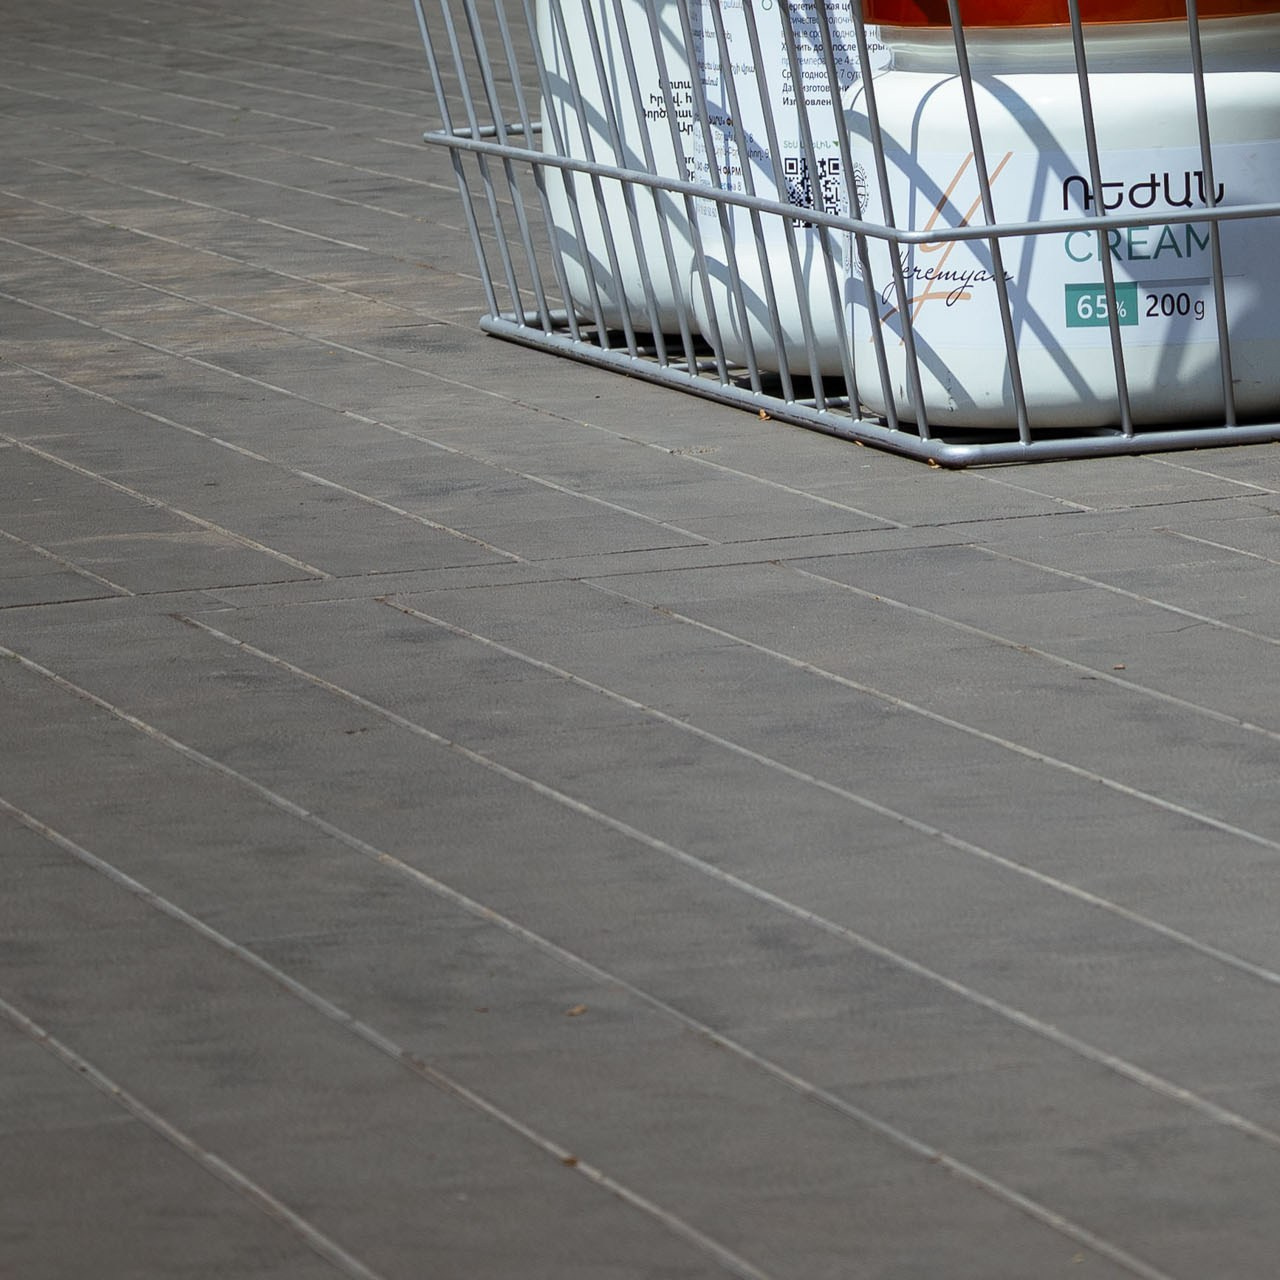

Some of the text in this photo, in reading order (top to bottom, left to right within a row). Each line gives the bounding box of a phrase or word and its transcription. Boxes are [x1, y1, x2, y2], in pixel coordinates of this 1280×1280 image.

[1062, 170, 1225, 211] ՌԵԺԱՆ
[1064, 223, 1213, 263] CREAM
[1076, 294, 1128, 320] 65%
